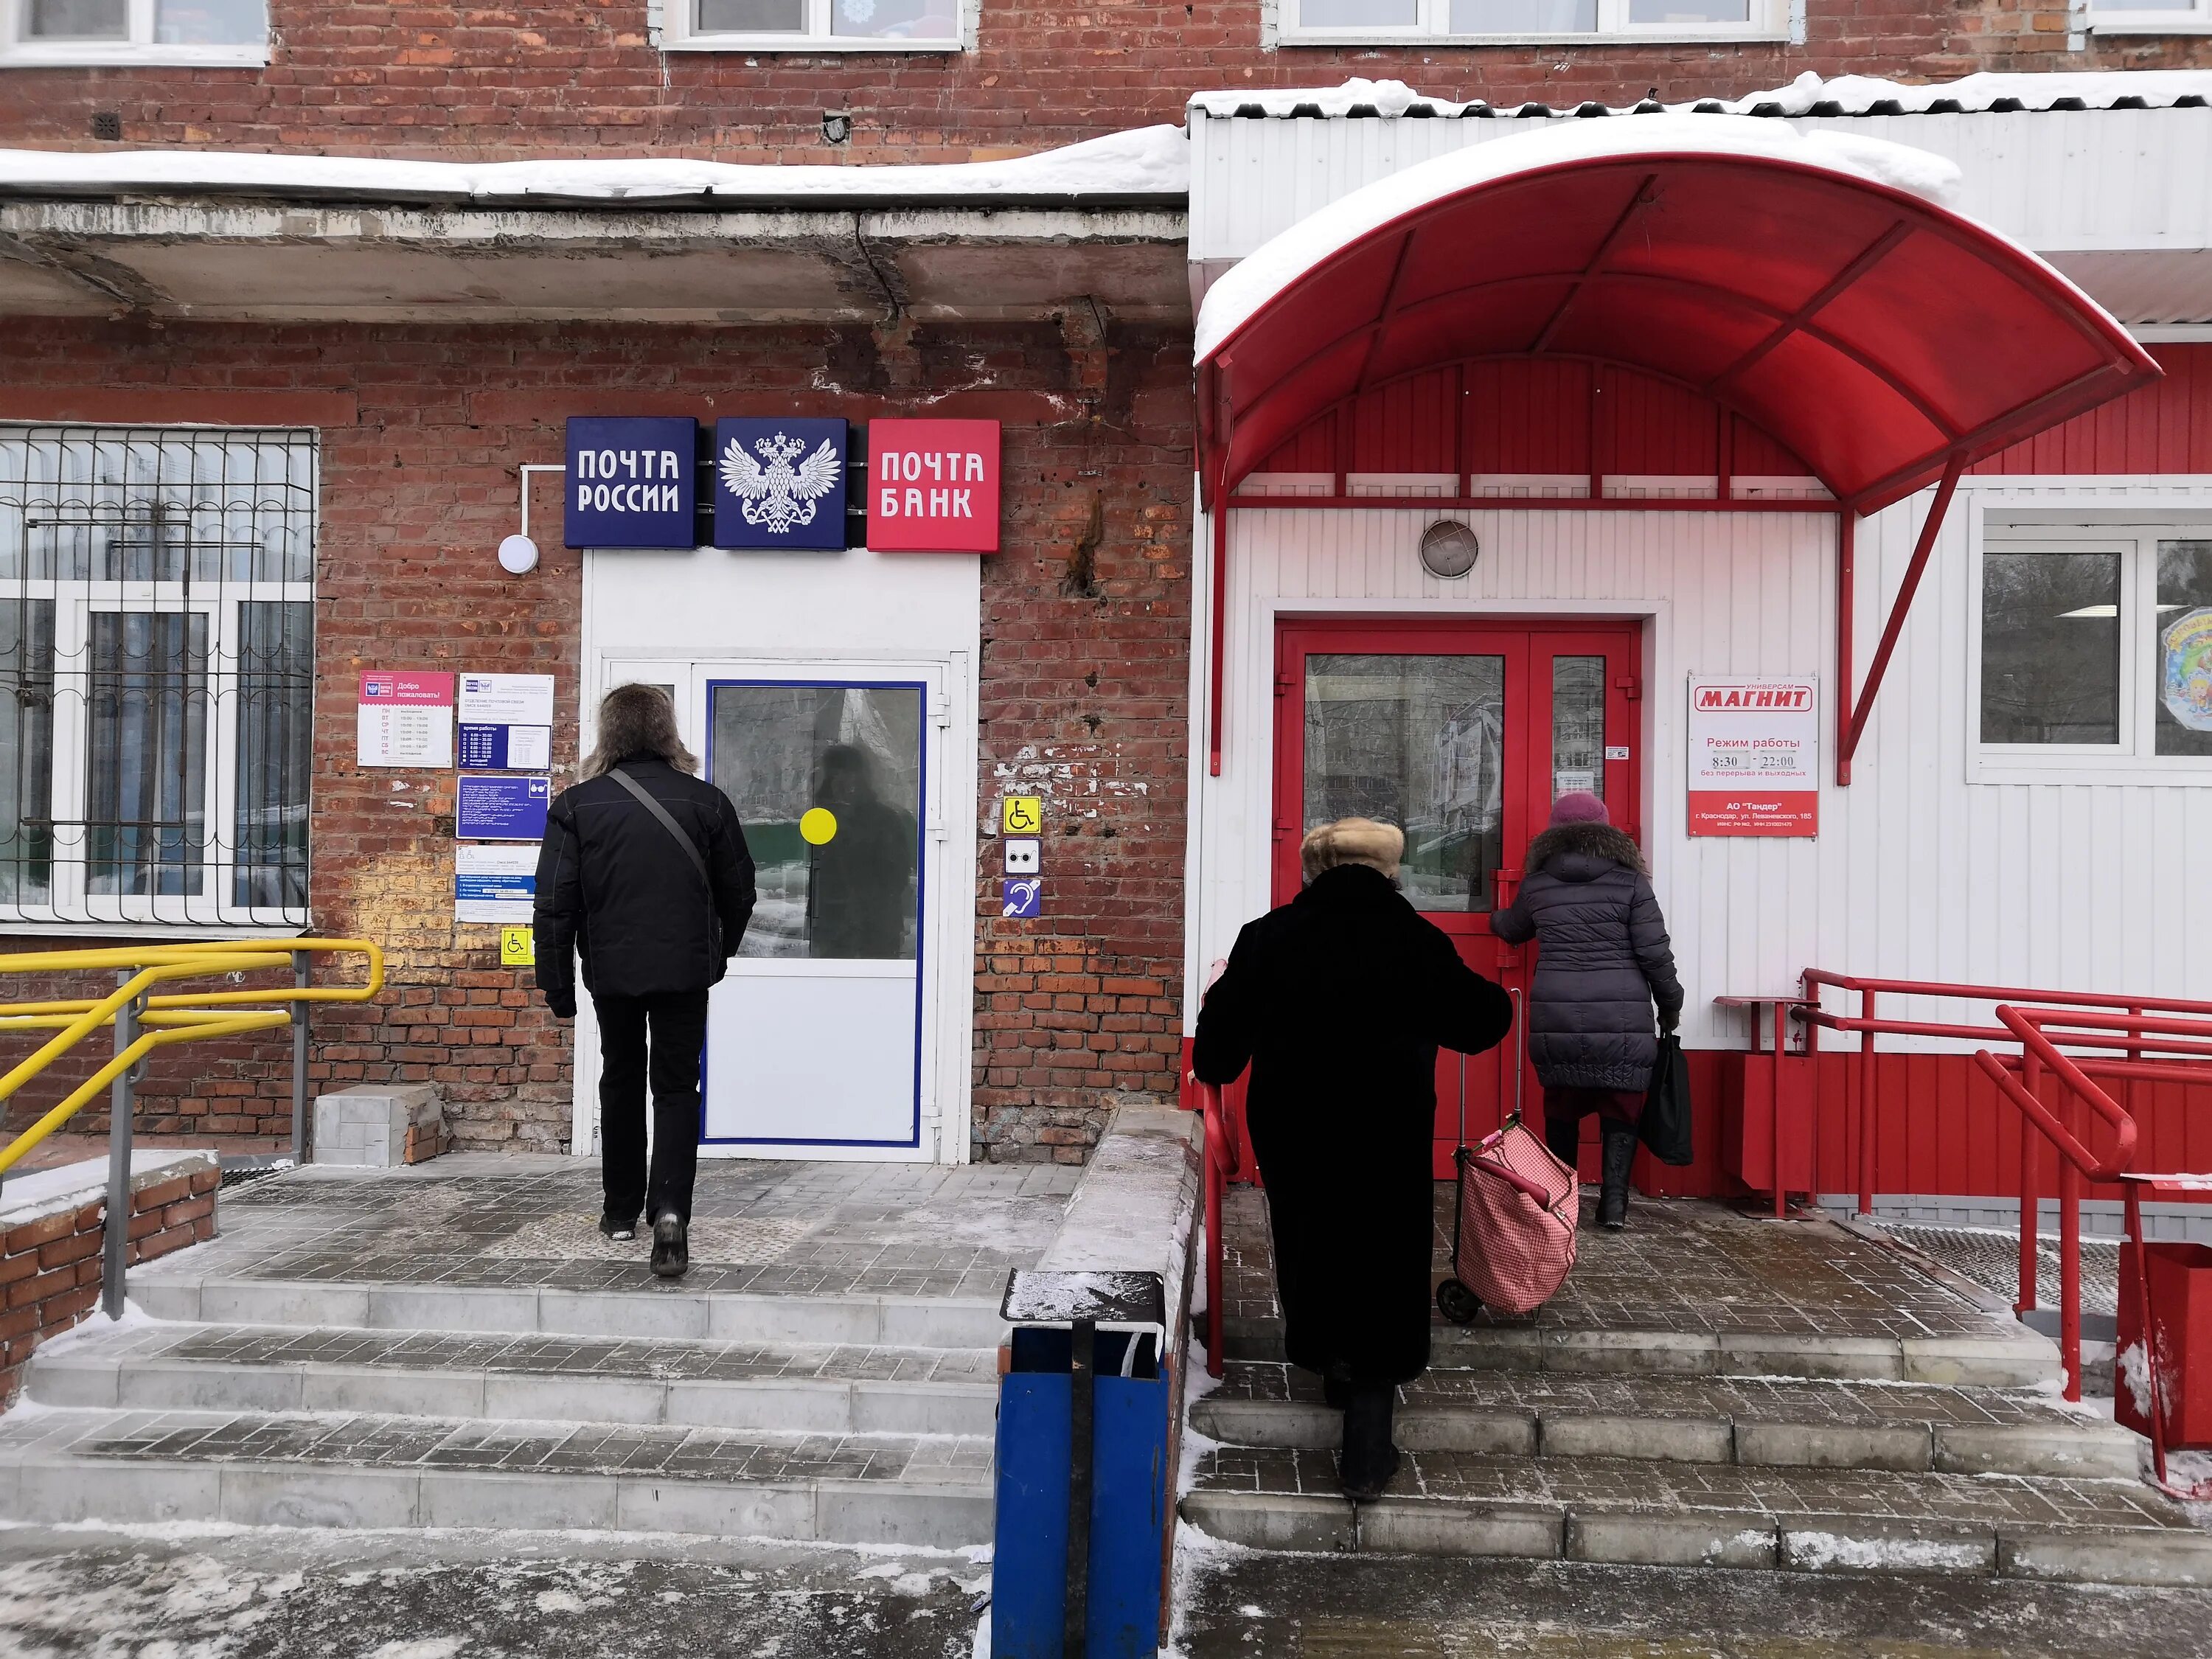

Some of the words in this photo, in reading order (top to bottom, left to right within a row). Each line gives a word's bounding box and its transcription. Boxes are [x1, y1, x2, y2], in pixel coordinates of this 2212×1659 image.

[578, 450, 679, 479] ПОЧТА
[881, 452, 984, 481] ПОЧТА
[578, 484, 679, 512] РОССИИ
[881, 487, 973, 518] БАНК
[397, 683, 420, 691] Добро
[1700, 691, 1806, 707] МАГНИТ
[1707, 738, 1749, 748] Режим
[1753, 737, 1801, 749] работы
[1712, 757, 1737, 767] 8:30
[1763, 757, 1794, 766] 22:00
